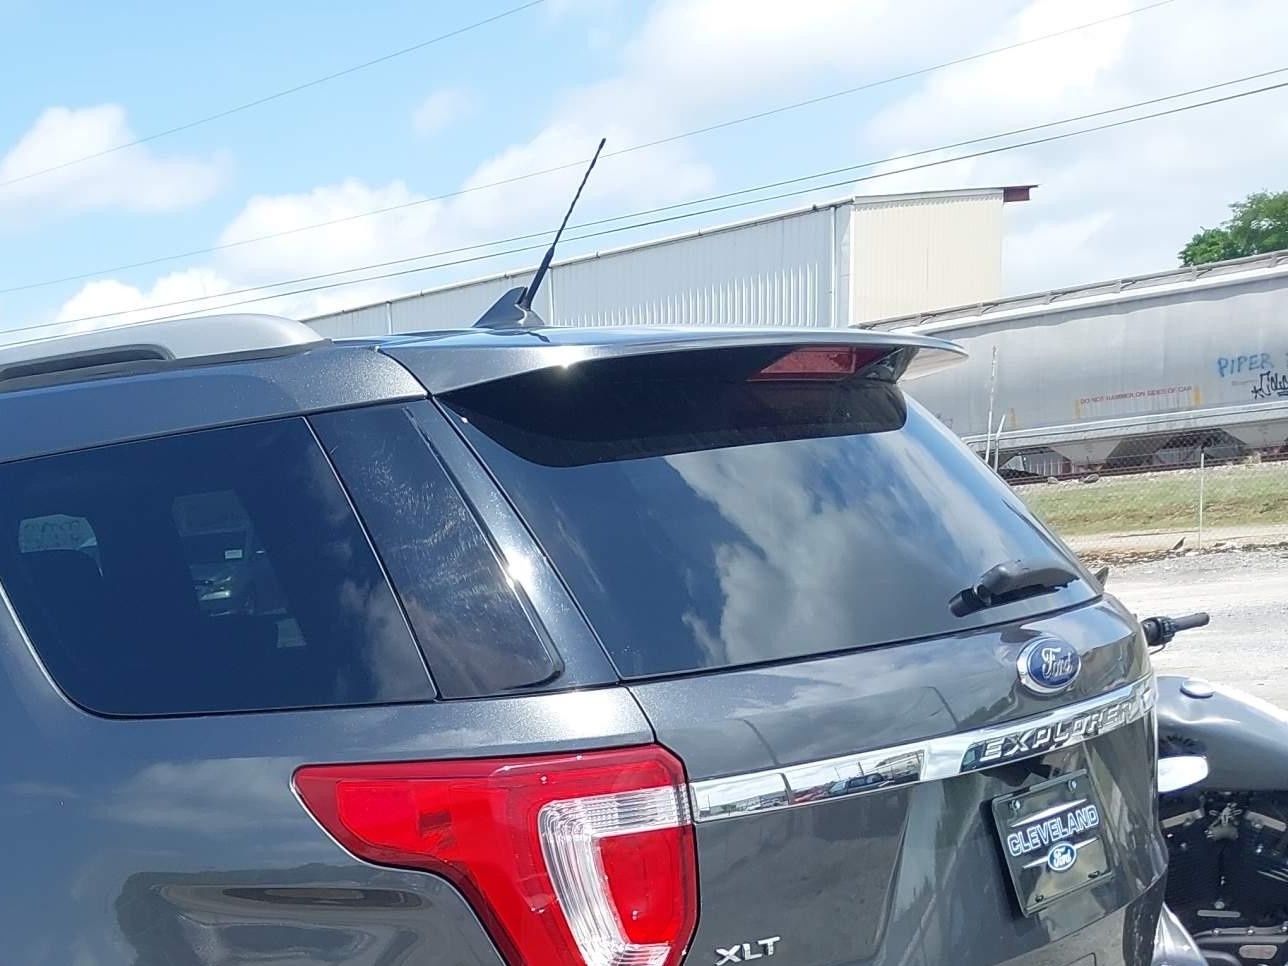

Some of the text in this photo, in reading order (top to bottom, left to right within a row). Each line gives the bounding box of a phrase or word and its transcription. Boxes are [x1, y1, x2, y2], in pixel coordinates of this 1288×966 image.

[1217, 353, 1274, 377] PIPER
[1041, 647, 1073, 678] Ford
[1007, 804, 1099, 857] CLEVELAND
[1053, 846, 1072, 868] Ford
[715, 936, 781, 966] XLT
